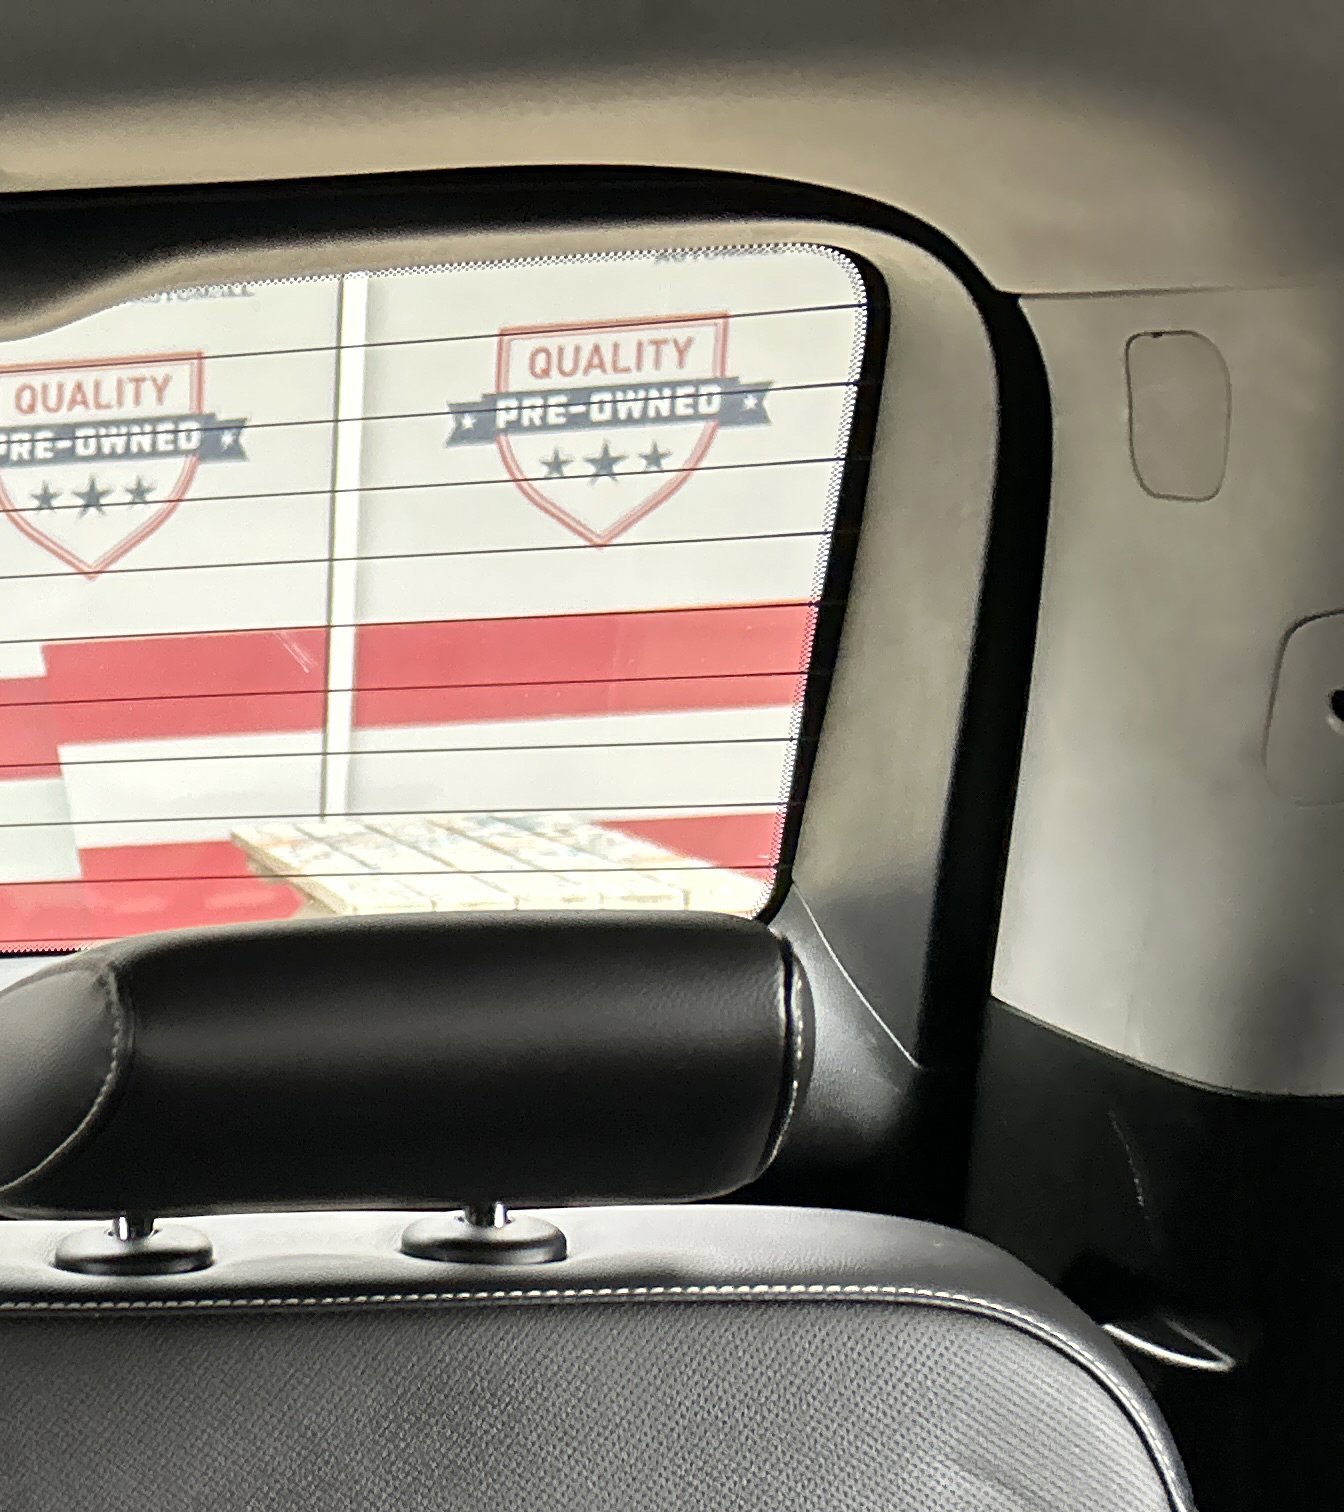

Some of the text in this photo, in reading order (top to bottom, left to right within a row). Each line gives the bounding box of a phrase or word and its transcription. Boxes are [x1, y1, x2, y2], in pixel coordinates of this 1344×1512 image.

[528, 336, 697, 380] QUALITY
[14, 373, 174, 415] QUALITY
[494, 383, 723, 430] PRE-OWNED
